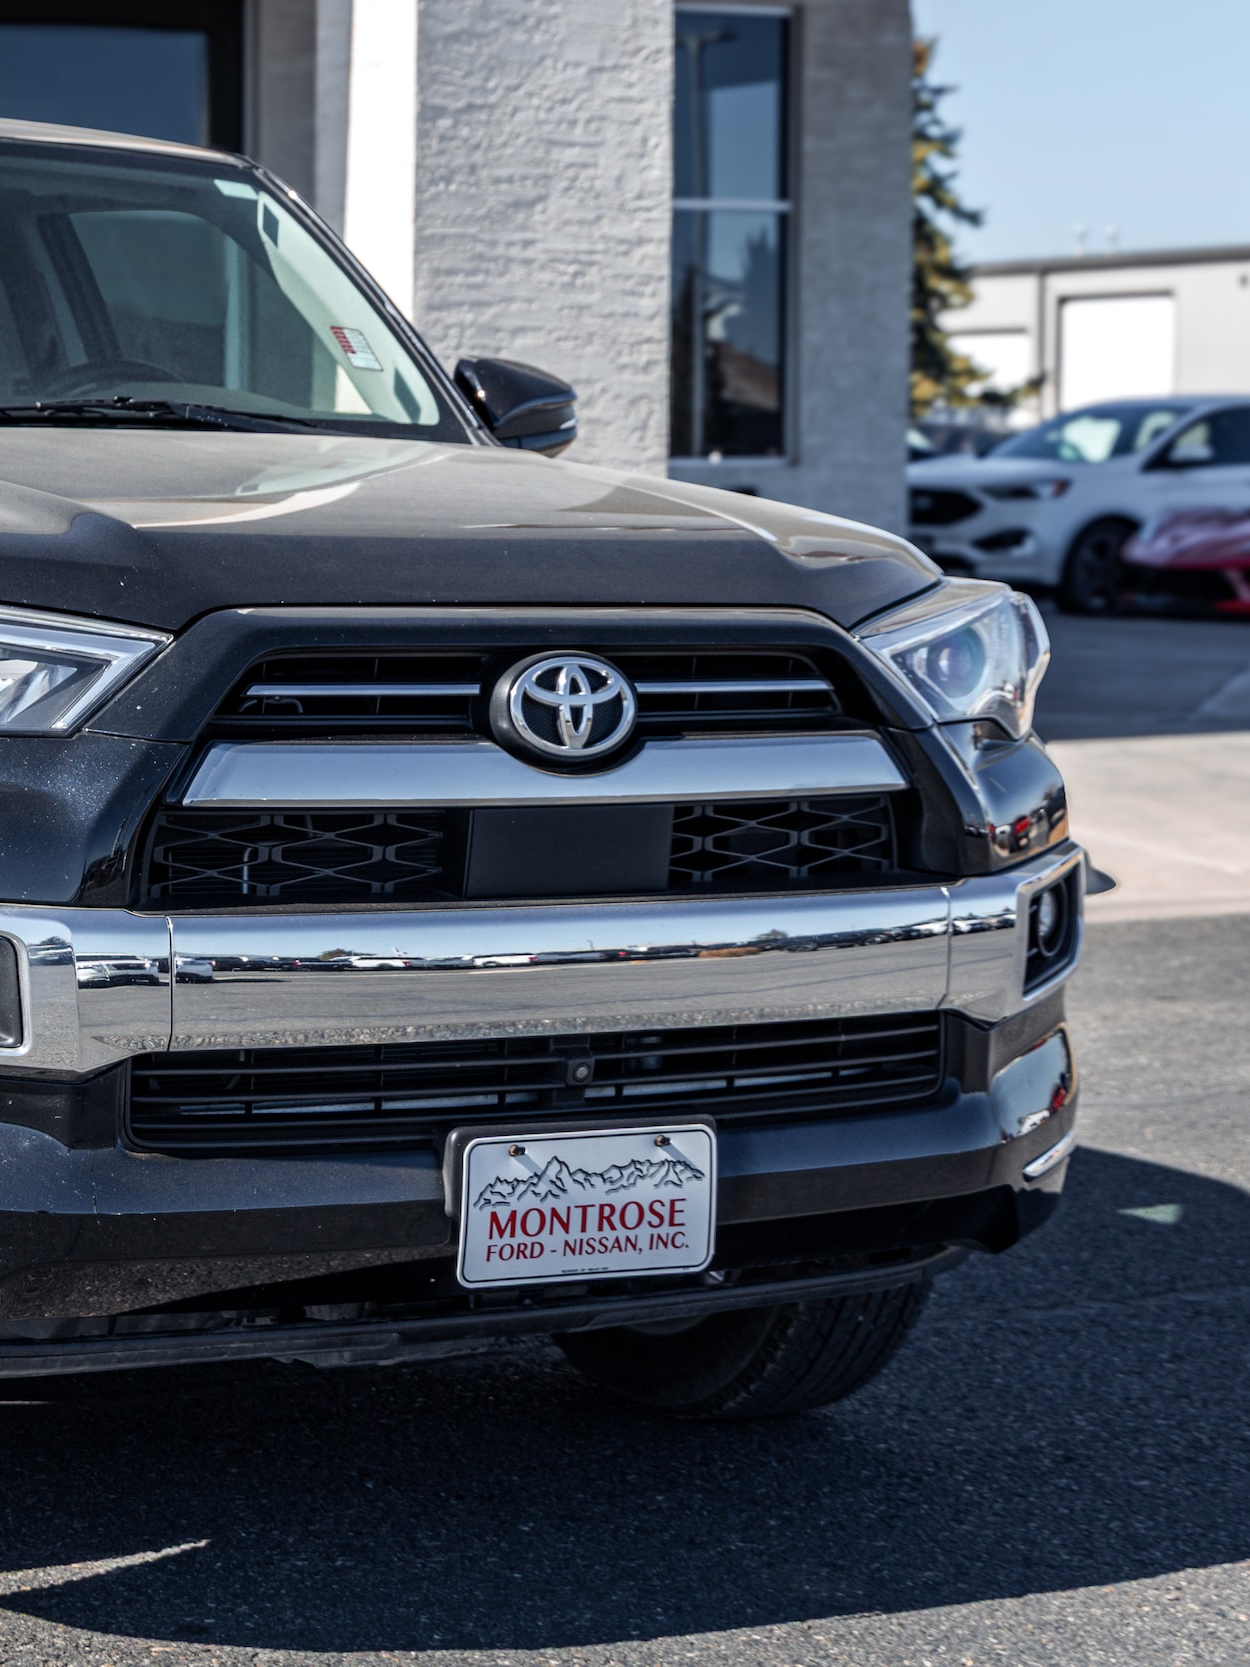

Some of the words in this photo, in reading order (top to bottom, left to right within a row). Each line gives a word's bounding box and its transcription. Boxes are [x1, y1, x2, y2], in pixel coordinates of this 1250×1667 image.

[488, 1198, 687, 1240] MONTROSE
[486, 1241, 544, 1263] FORD
[563, 1234, 643, 1257] NISSAN,
[649, 1231, 690, 1251] INC.
